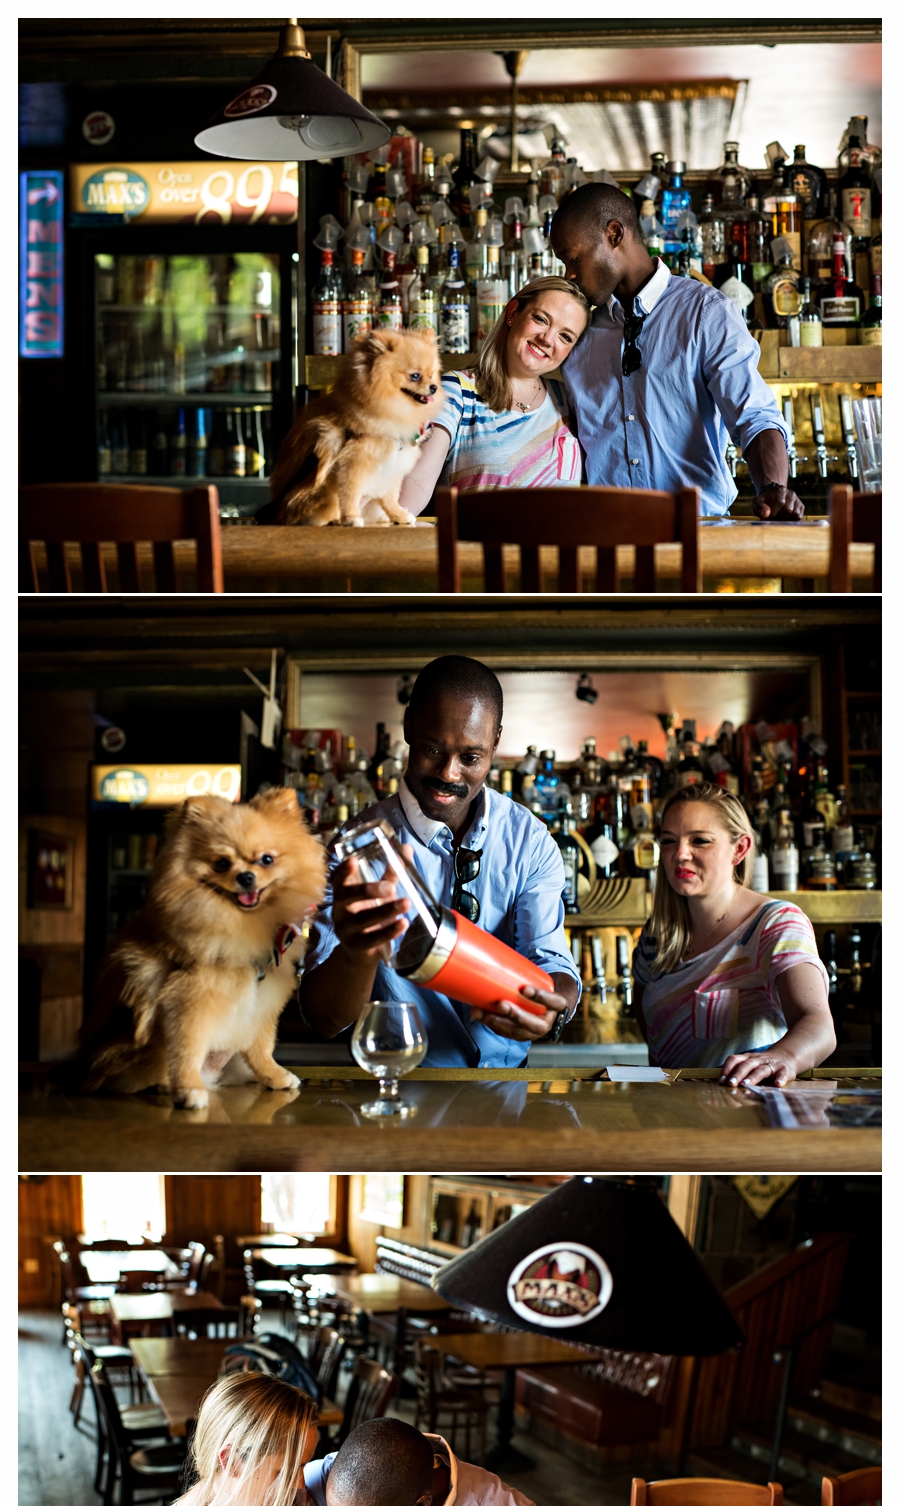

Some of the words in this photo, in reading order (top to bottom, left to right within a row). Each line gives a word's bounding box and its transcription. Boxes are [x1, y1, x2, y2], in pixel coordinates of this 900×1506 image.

[157, 168, 193, 188] Open
[87, 181, 146, 206] MAX'S
[159, 187, 200, 204] over
[849, 193, 865, 218] 7
[102, 776, 148, 797] MAX'S
